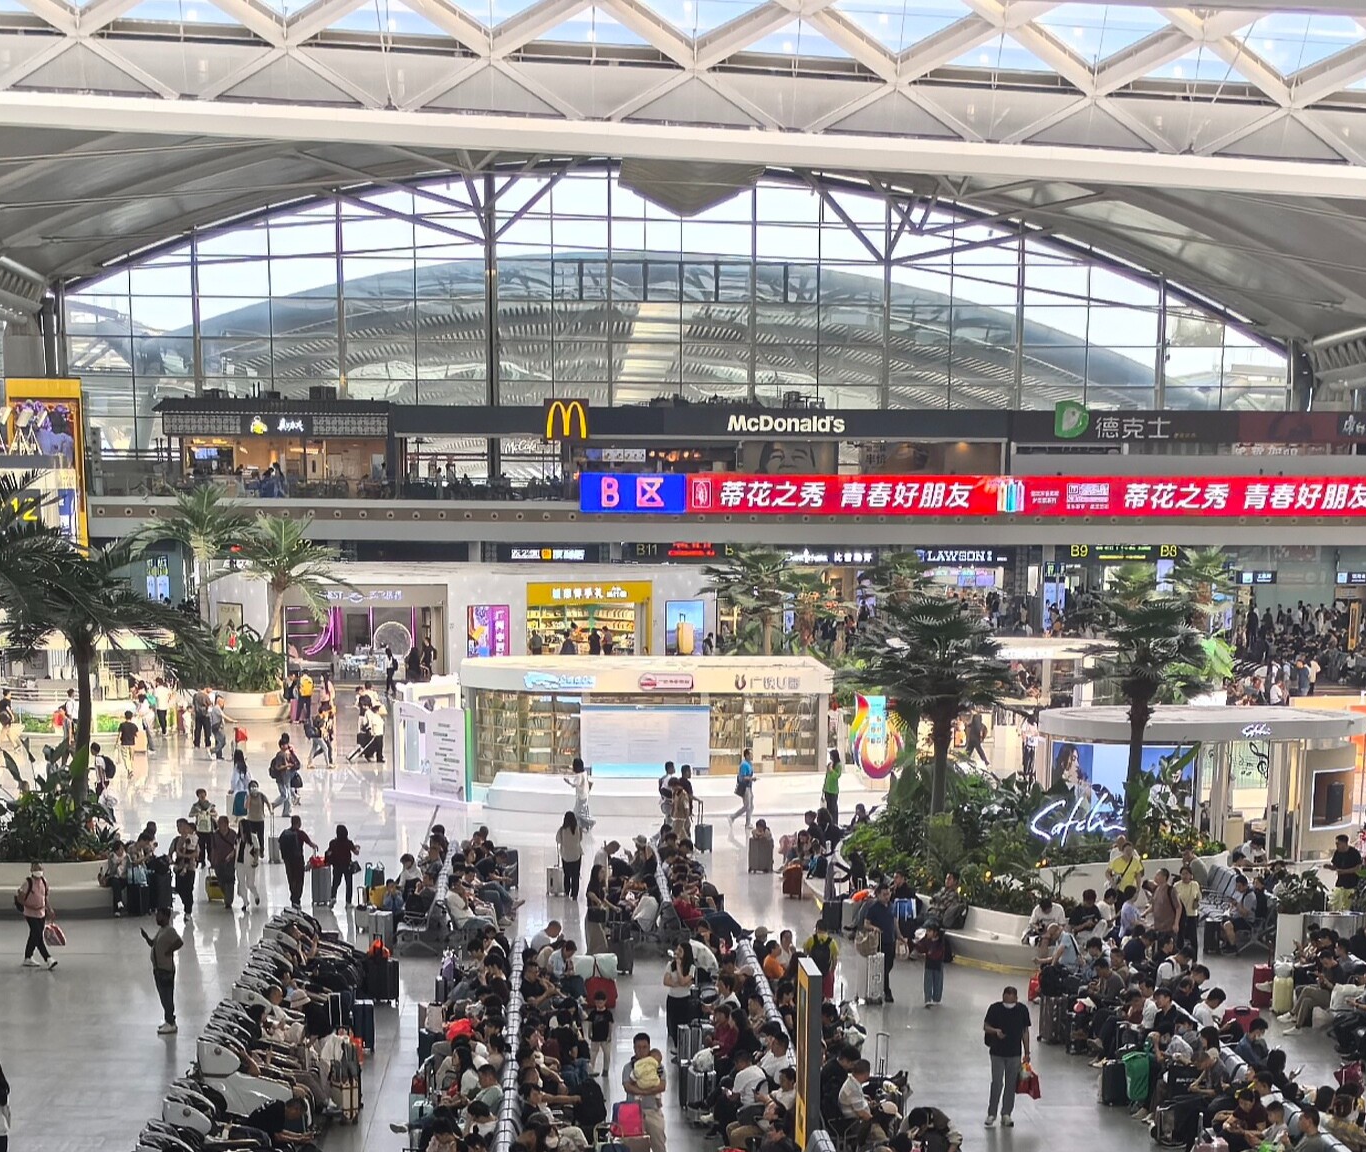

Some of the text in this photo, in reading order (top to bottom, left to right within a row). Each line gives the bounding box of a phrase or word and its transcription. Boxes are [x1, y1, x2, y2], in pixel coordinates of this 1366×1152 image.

[727, 415, 845, 433] McDonald's
[1095, 417, 1171, 439] 德克士
[636, 477, 666, 508] 区
[720, 481, 973, 508] 蒂花之秀 青春好朋友
[1124, 483, 1230, 510] 蒂花之秀
[927, 550, 986, 562] LAWSON
[1070, 544, 1088, 557] B9
